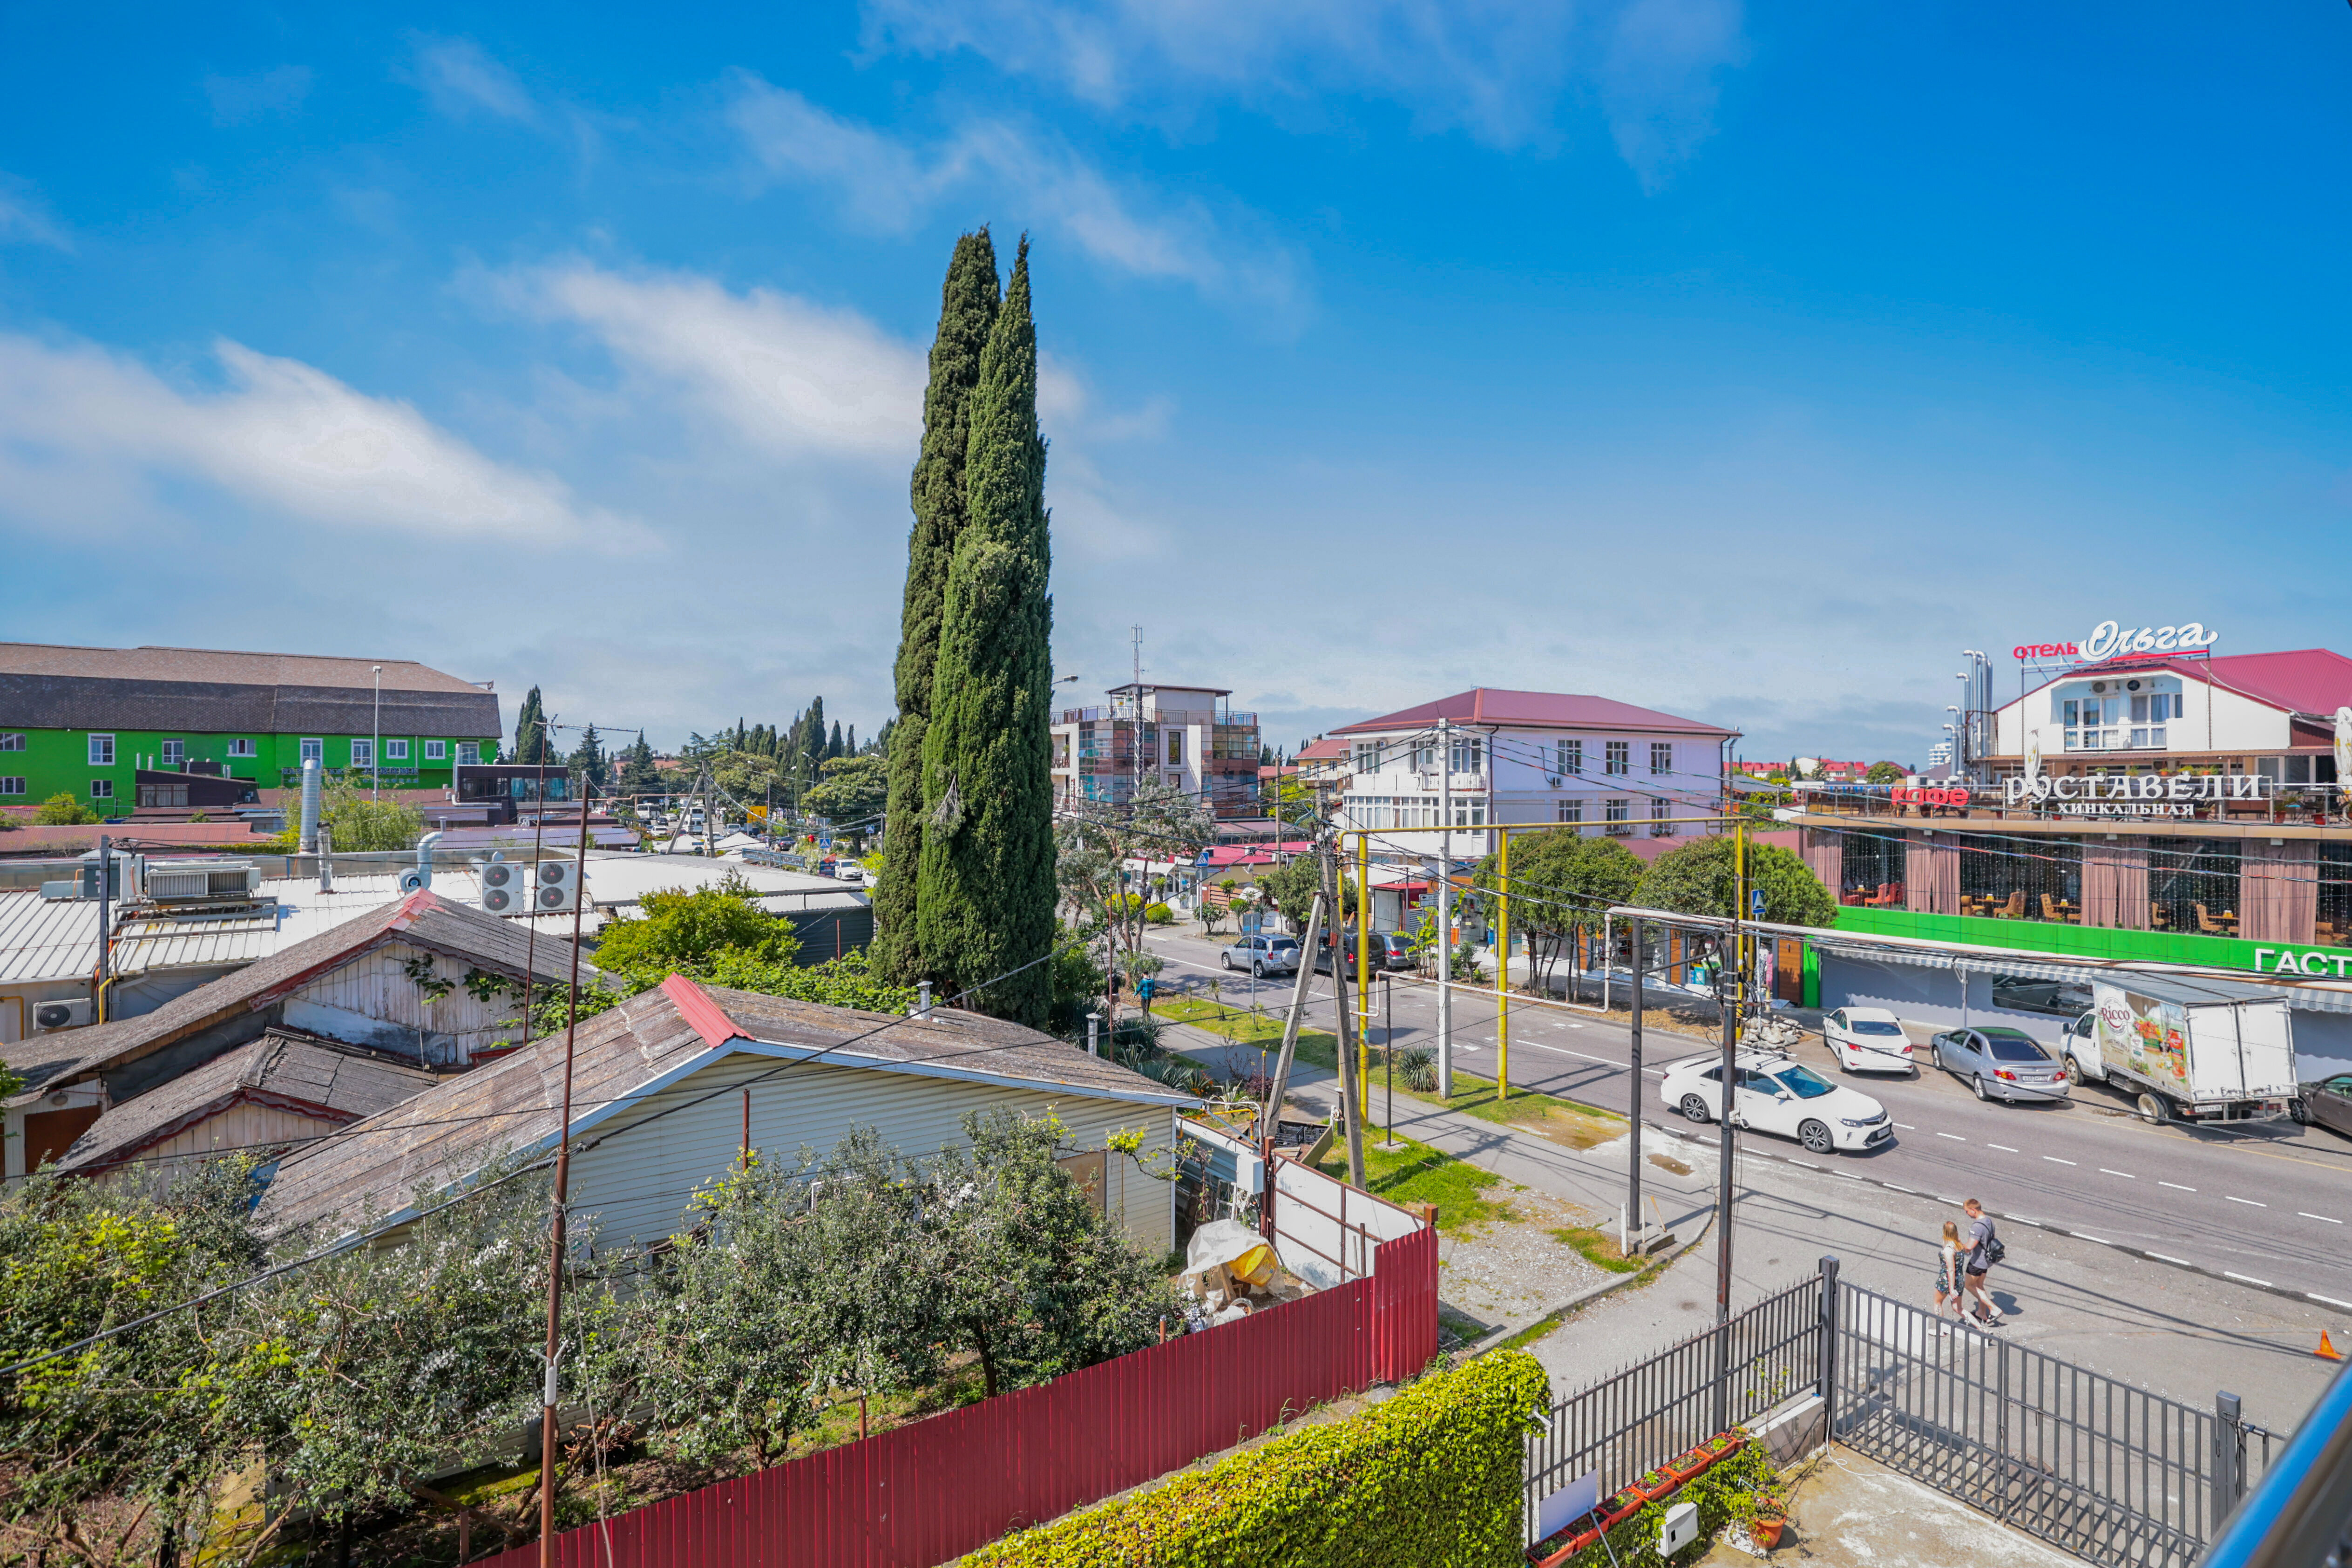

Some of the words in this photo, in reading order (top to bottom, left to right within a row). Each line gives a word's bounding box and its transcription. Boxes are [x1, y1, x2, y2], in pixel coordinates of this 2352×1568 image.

[2078, 620, 2219, 661] Ольга
[2006, 774, 2264, 805] РУСТАВЕЛИ
[2057, 803, 2195, 815] ХИНКАЛЬНАЯ
